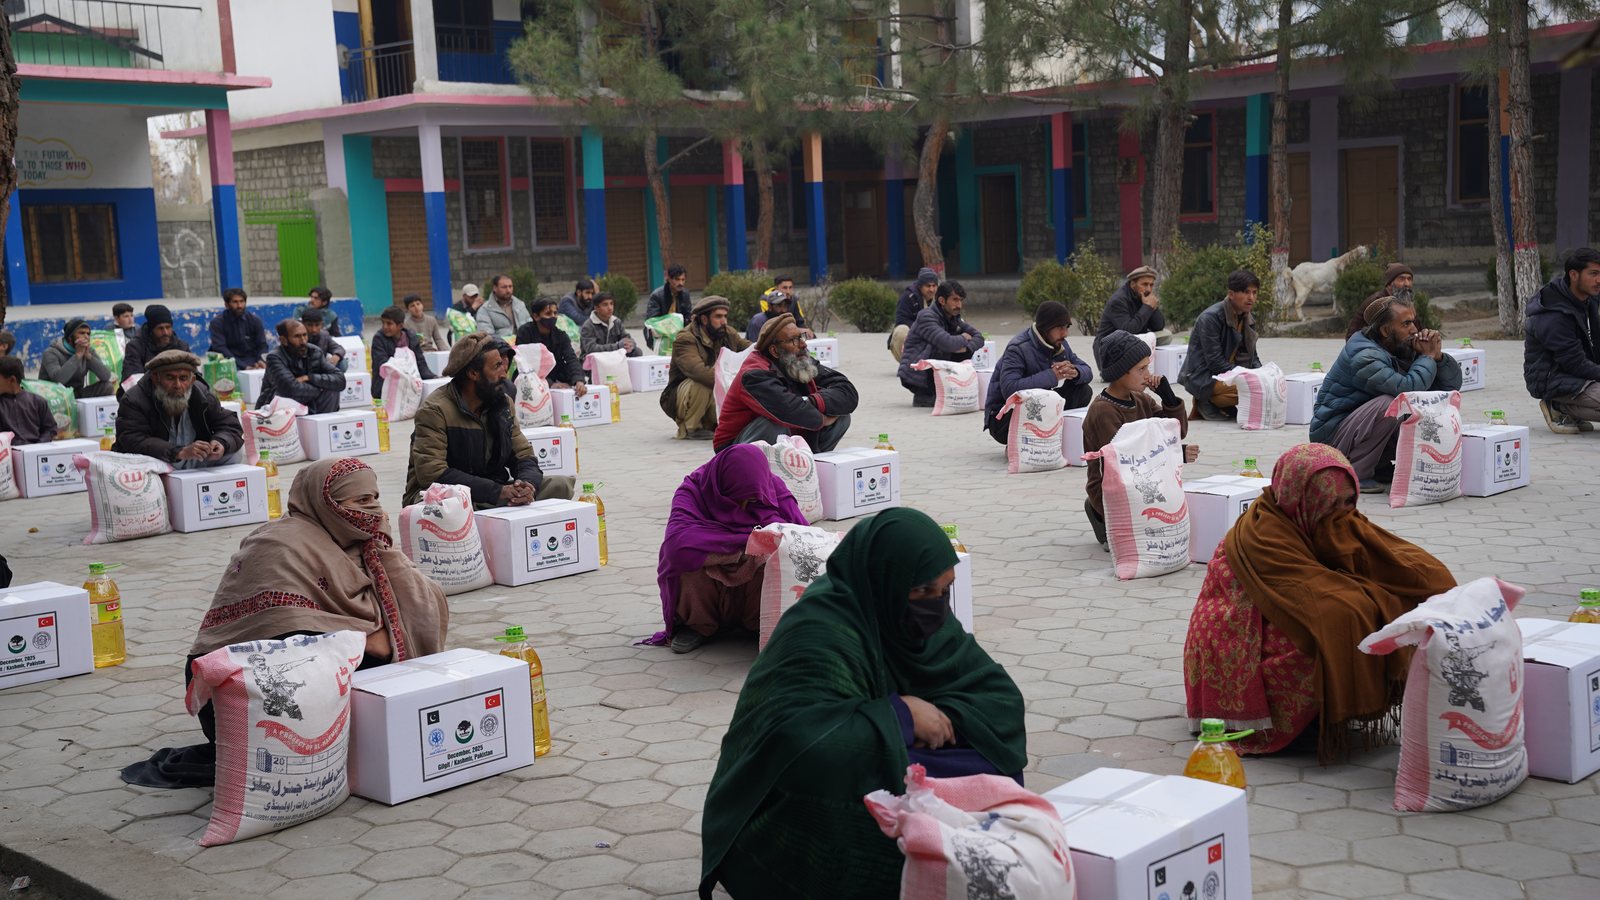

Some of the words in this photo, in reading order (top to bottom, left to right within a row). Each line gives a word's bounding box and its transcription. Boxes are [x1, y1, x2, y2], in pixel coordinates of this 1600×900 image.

[27, 160, 36, 169] TO
[40, 160, 62, 170] THOSE
[65, 160, 86, 170] WHO
[279, 730, 305, 748] PROJECT
[438, 761, 451, 770] Gilgit
[454, 755, 474, 766] Kashmir,
[474, 750, 494, 760] Pakistan
[447, 748, 472, 760] December,
[472, 744, 484, 754] 2025
[1458, 751, 1470, 760] 20
[273, 757, 285, 766] 20
[249, 776, 271, 792] ملز
[272, 780, 302, 797] جنرل
